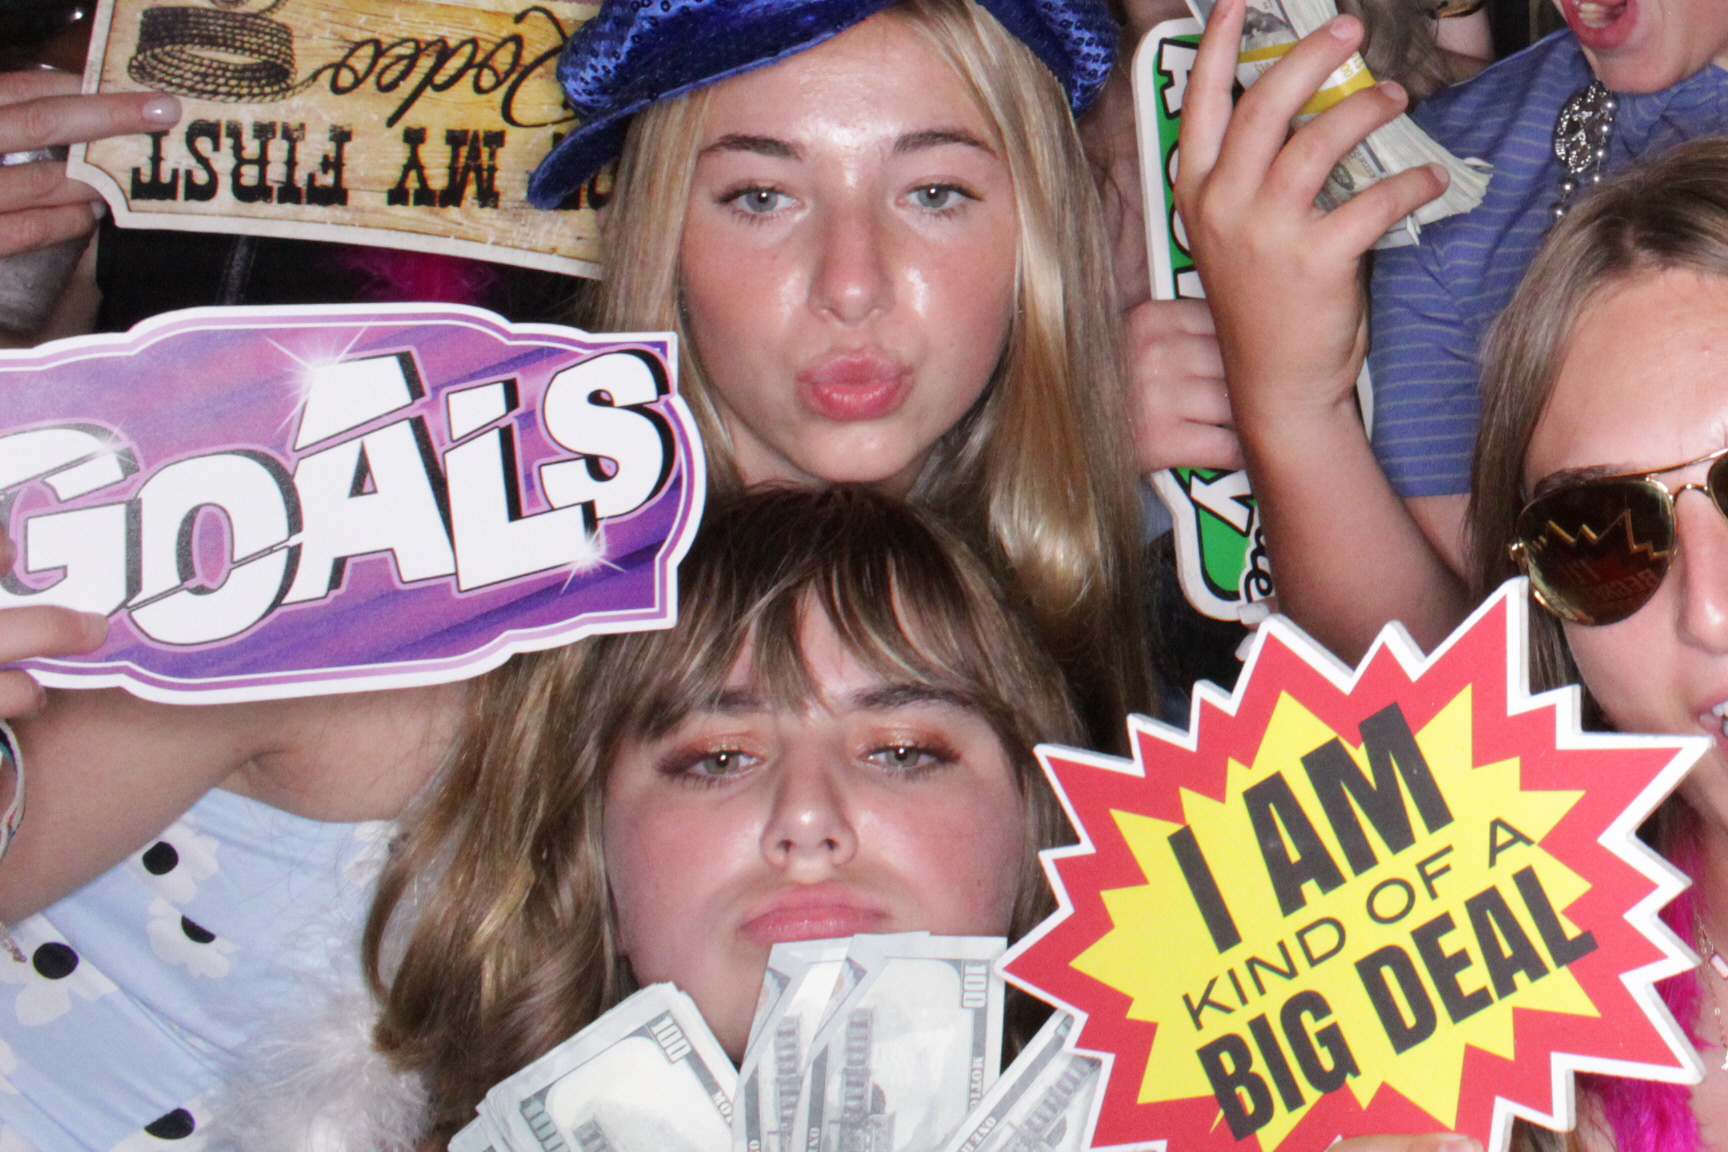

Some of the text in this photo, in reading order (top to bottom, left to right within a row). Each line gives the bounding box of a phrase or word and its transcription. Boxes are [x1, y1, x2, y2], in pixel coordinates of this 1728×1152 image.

[130, 119, 352, 206] FIRST
[387, 126, 506, 209] MY
[0, 347, 672, 646] GOALS
[1167, 701, 1455, 954] I AM
[1183, 817, 1536, 1031] KIND OF A
[1195, 864, 1598, 1142] BIG DEAL
